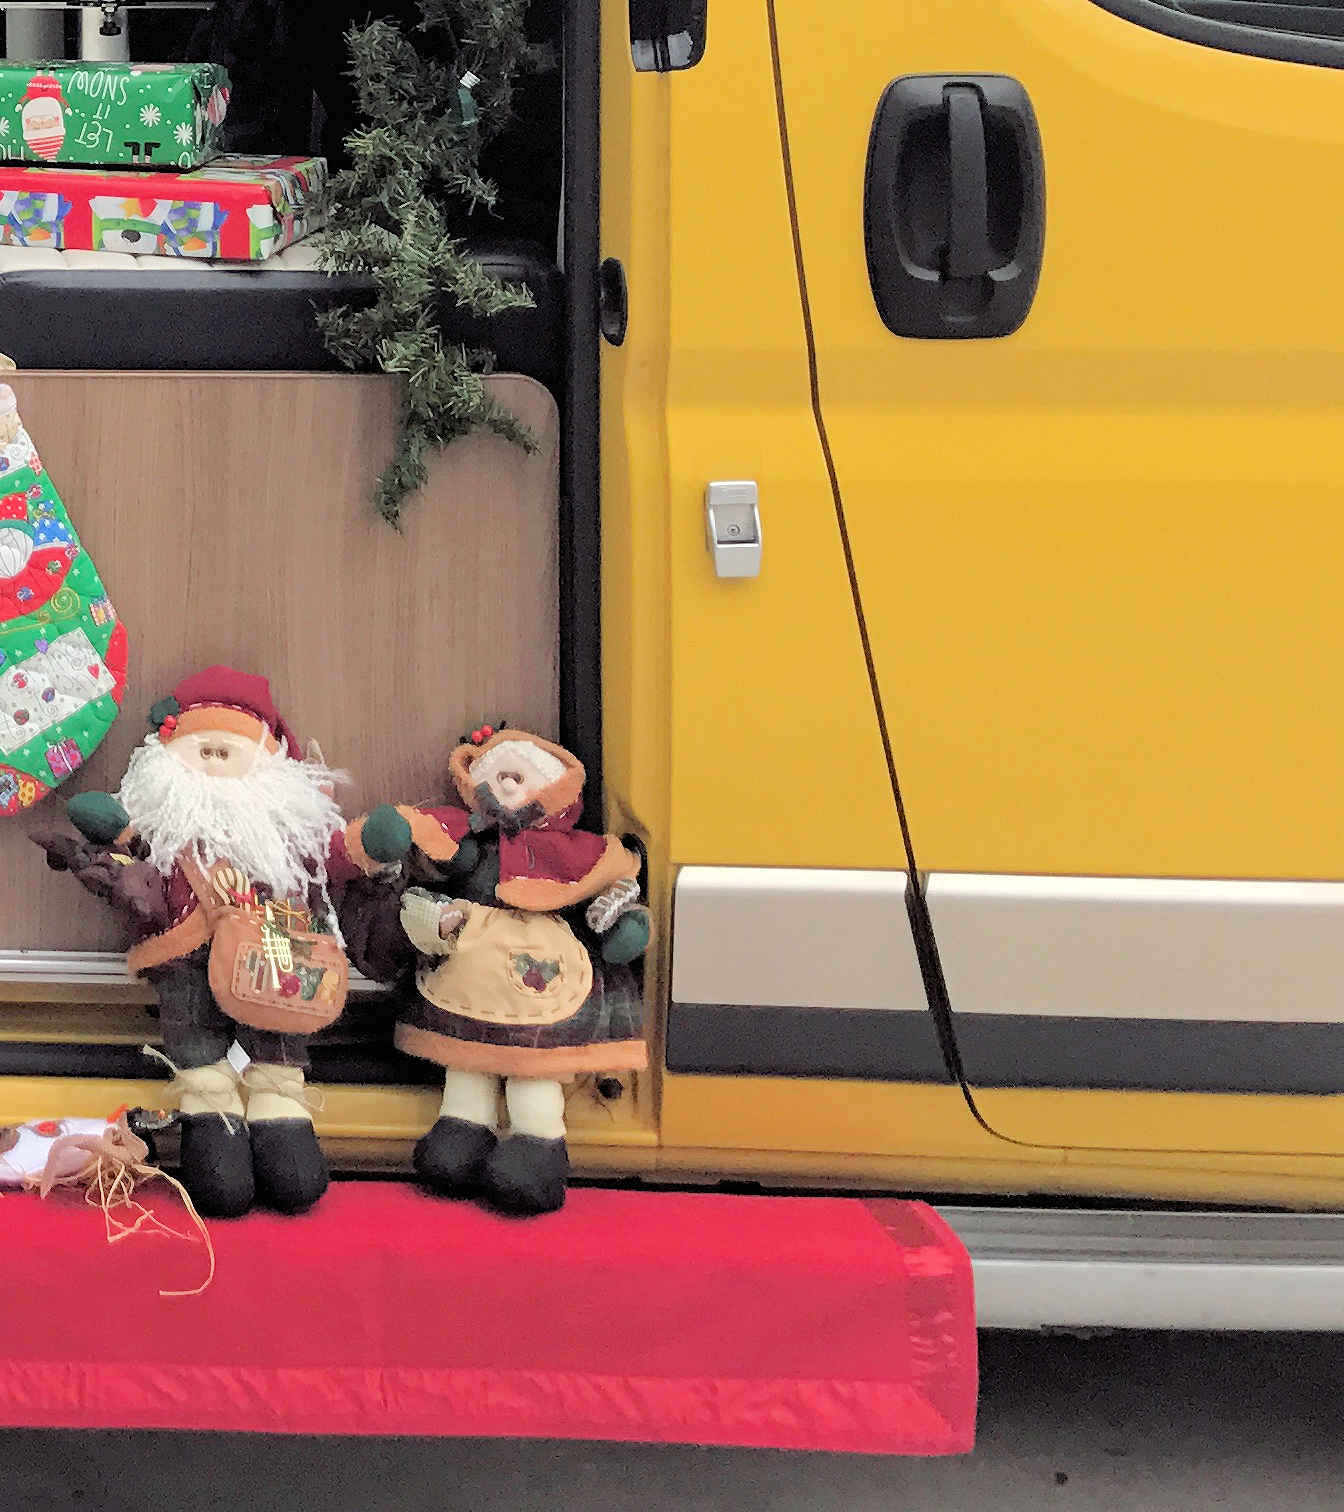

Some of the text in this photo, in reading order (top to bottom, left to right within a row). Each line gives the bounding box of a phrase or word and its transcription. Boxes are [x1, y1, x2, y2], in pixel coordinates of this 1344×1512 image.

[66, 71, 130, 105] SNOW
[93, 102, 111, 120] IT
[74, 120, 114, 153] LET
